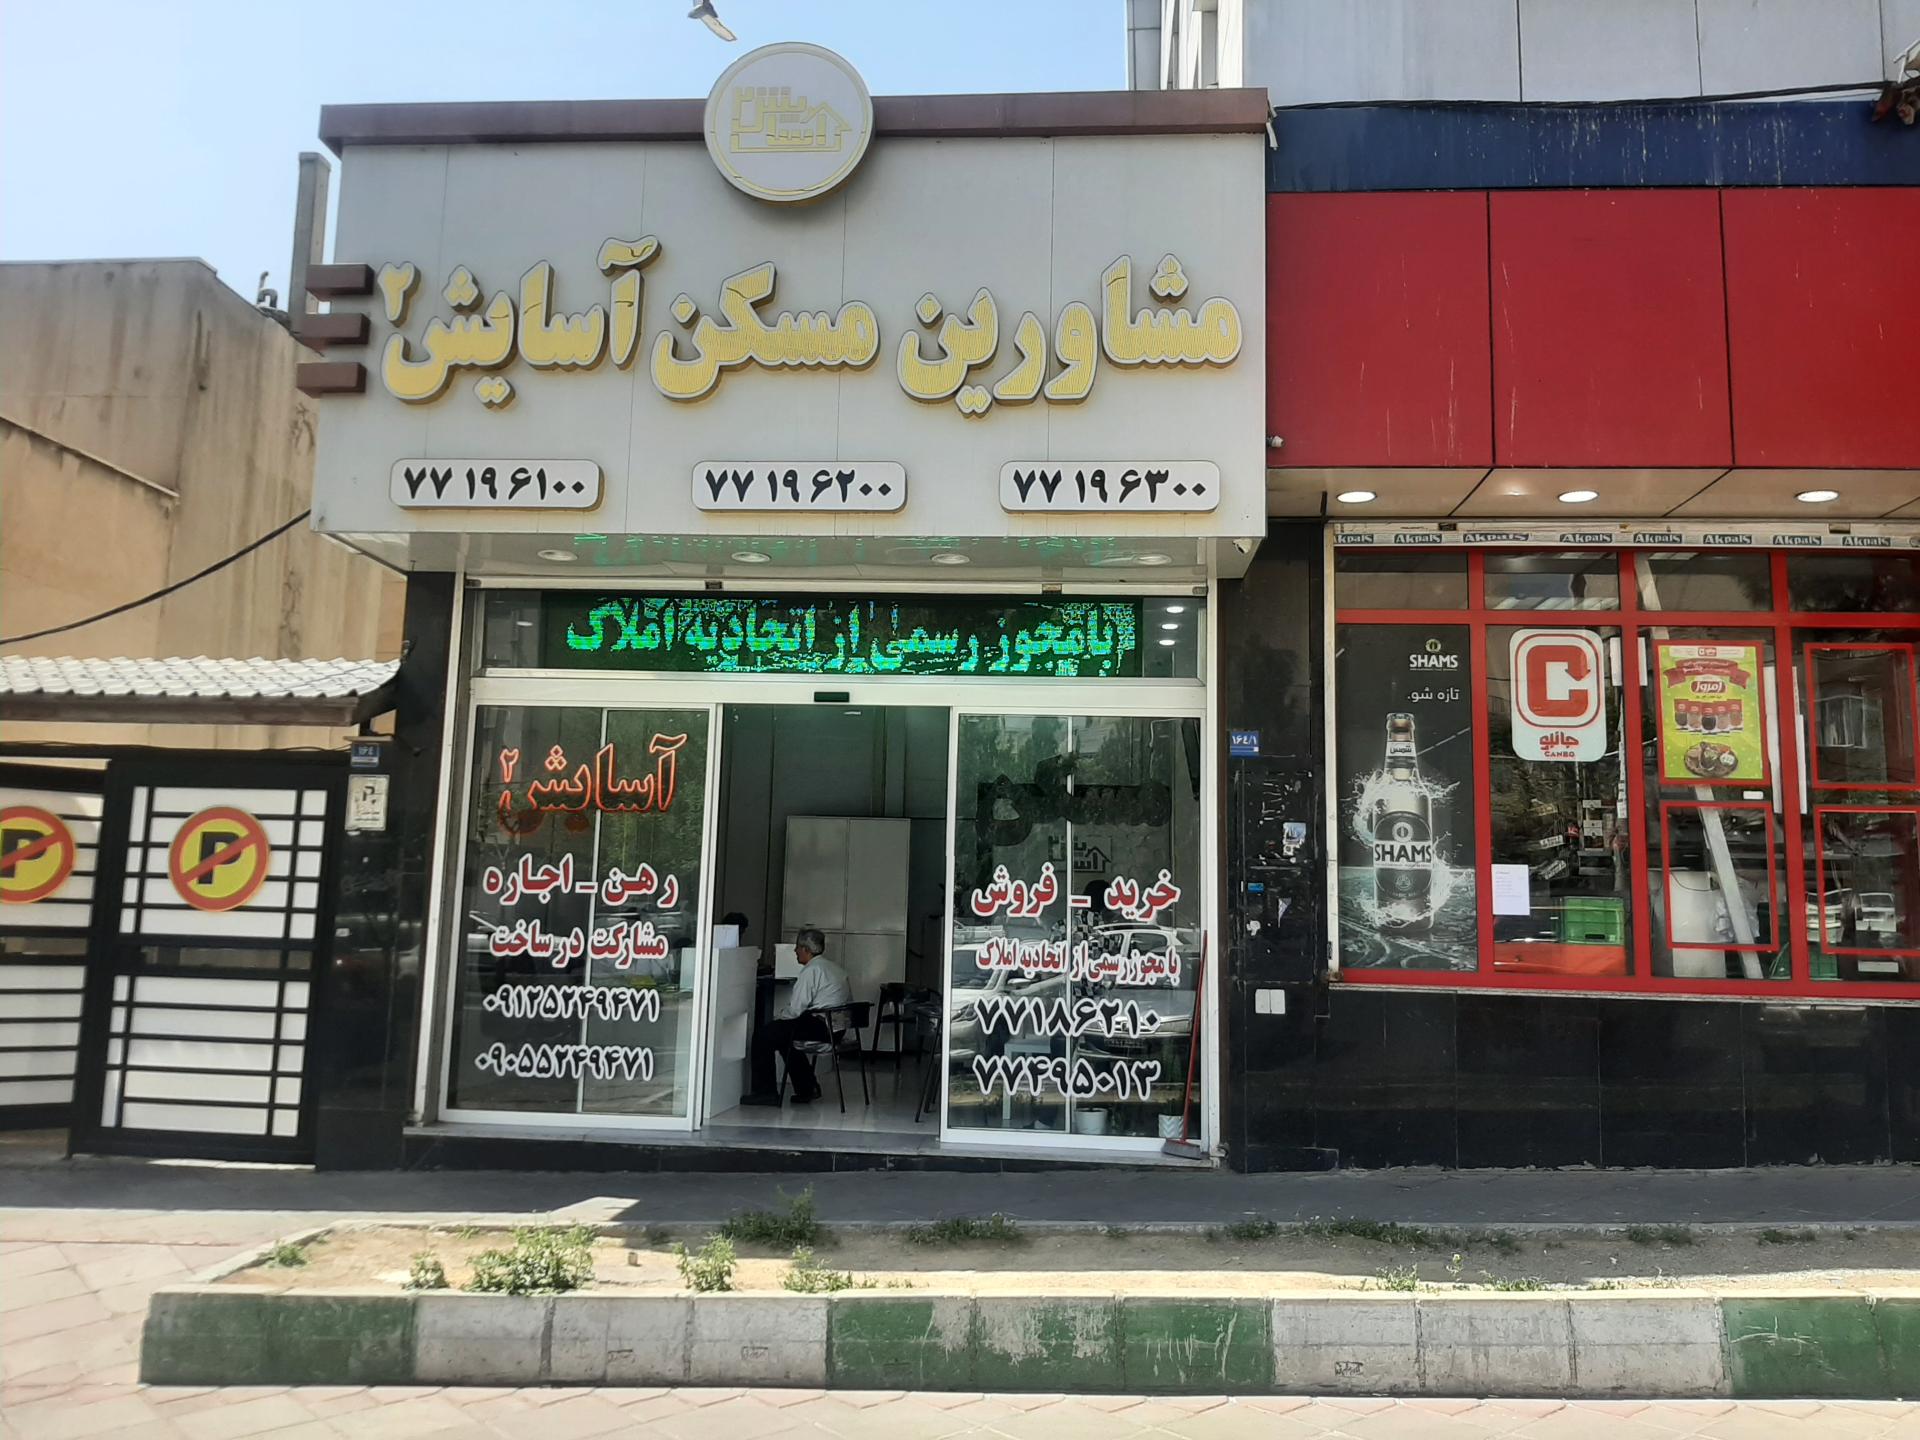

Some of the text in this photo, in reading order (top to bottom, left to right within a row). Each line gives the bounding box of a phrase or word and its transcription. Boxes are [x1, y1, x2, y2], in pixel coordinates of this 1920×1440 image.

[377, 235, 1243, 416] مشاورین مسکن آسایش ۲
[566, 600, 677, 651] املاک
[824, 603, 860, 672] از
[871, 626, 979, 672] رسمی
[1409, 654, 1458, 668] SHAMS
[1437, 687, 1460, 703] تازه
[500, 733, 687, 832] آسایش ۲
[1375, 844, 1431, 863] SHAMS
[483, 853, 573, 905] اجاره
[602, 863, 679, 907] رهن
[972, 862, 1058, 917] فروش
[1105, 869, 1181, 920] خرید
[490, 919, 669, 969] مشارکت در ساخت
[976, 936, 1020, 970] املاک
[1019, 938, 1067, 979] اتحادیه
[1071, 940, 1089, 980] از
[1167, 945, 1181, 986] با
[1087, 949, 1131, 985] رسمی
[974, 996, 1162, 1038] ۷۷۱۸۶۲۱۰
[475, 1043, 654, 1080] ۰۹۰۵۵۲۴۹۴۷۱
[973, 1054, 1162, 1100] ۷۷۴۹۵۰۱۳
